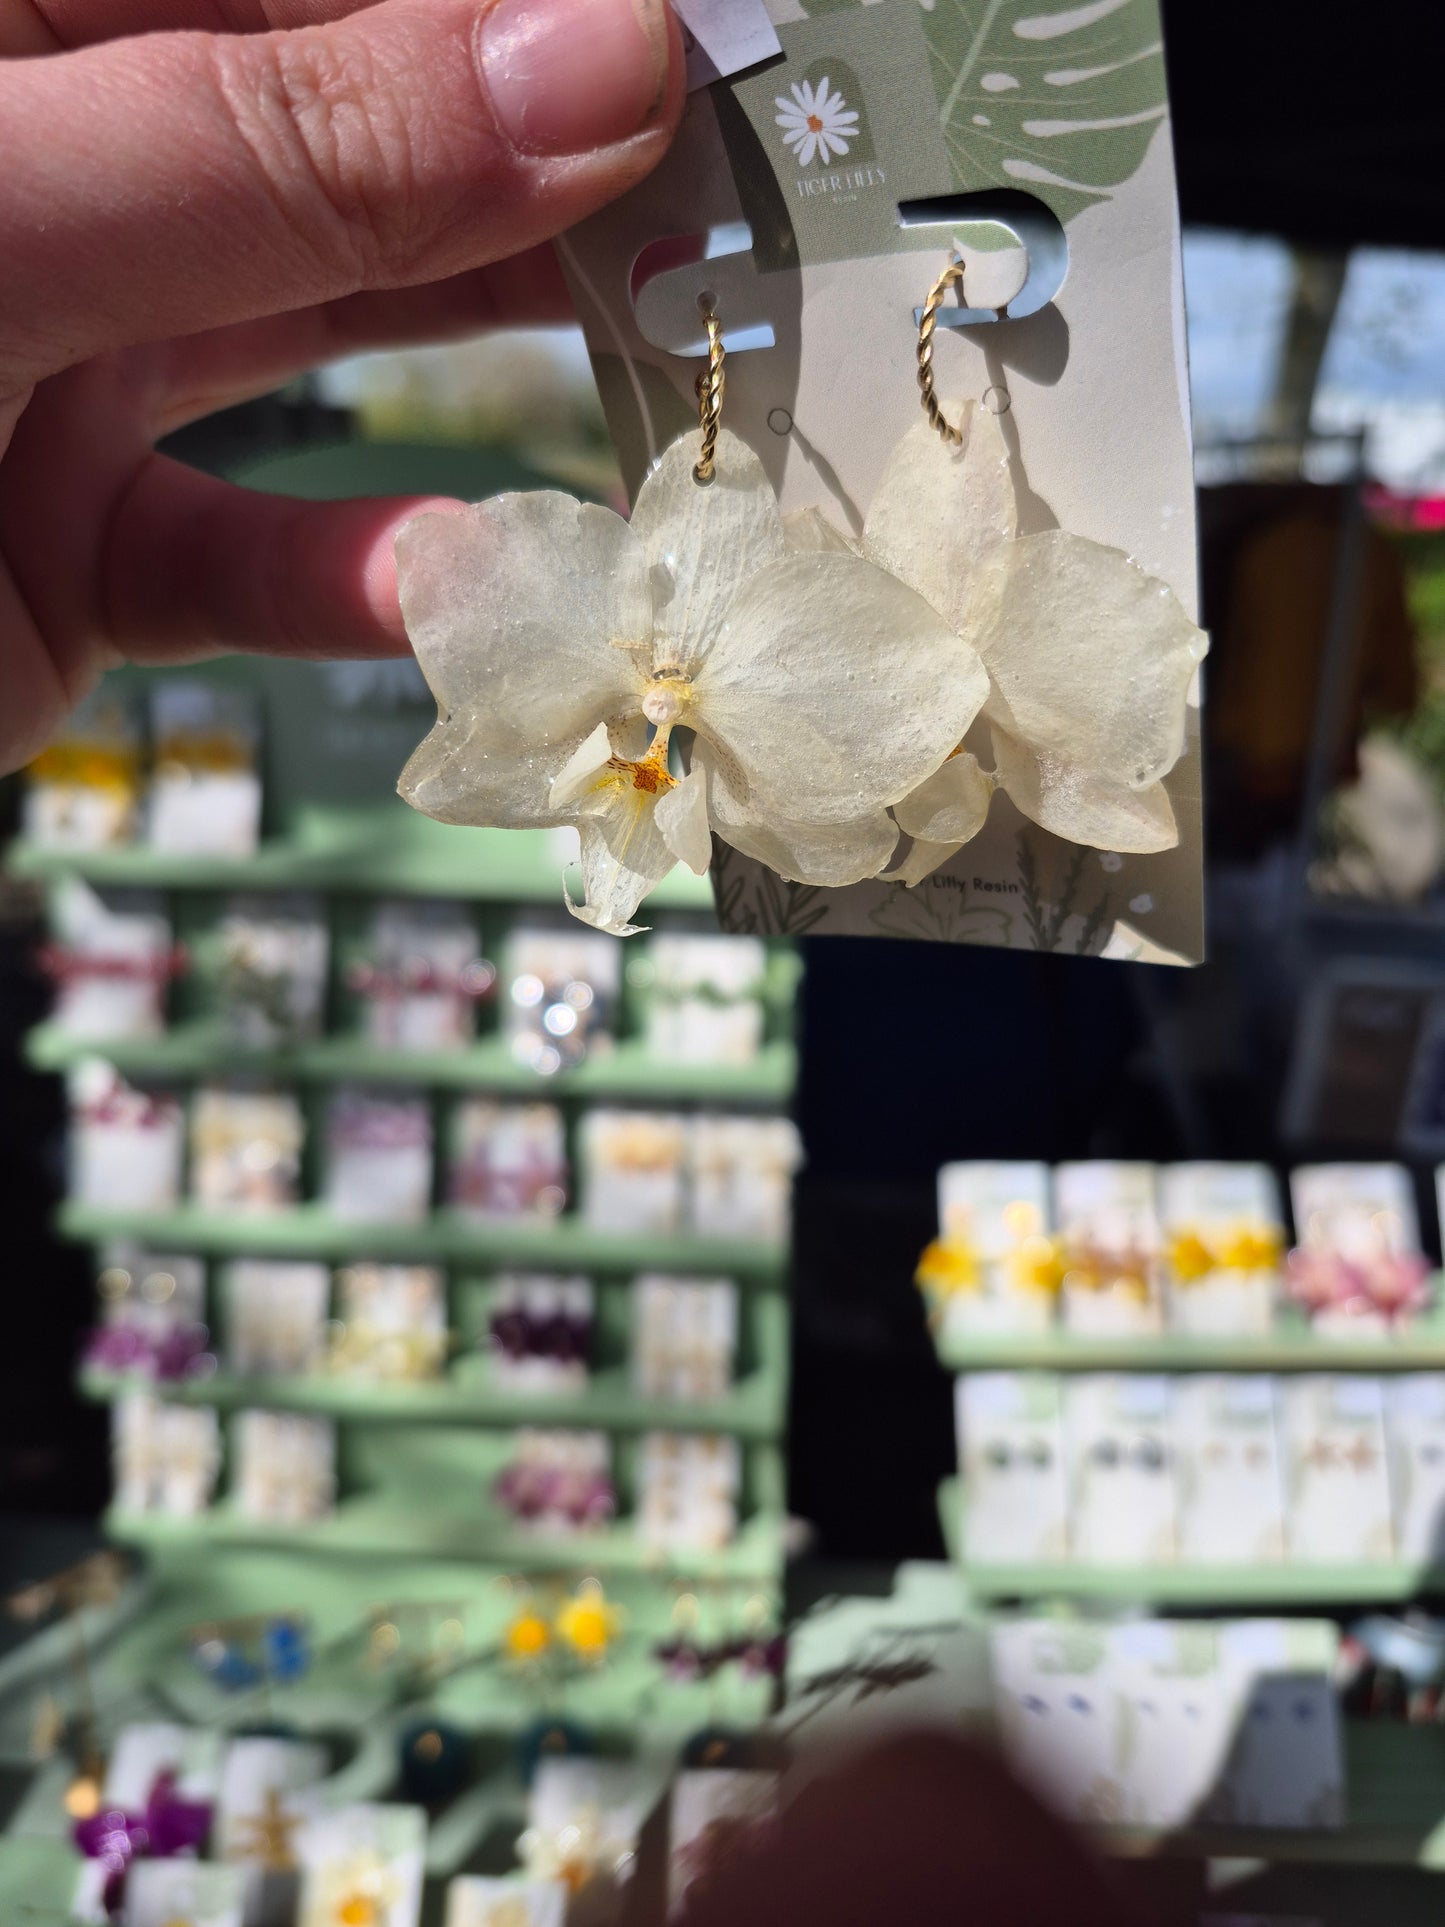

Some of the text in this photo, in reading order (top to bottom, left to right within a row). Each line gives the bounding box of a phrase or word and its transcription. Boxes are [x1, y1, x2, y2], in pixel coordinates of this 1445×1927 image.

[796, 174, 843, 197] TIGER
[932, 875, 966, 893] Lilly
[973, 877, 1018, 893] Resin
